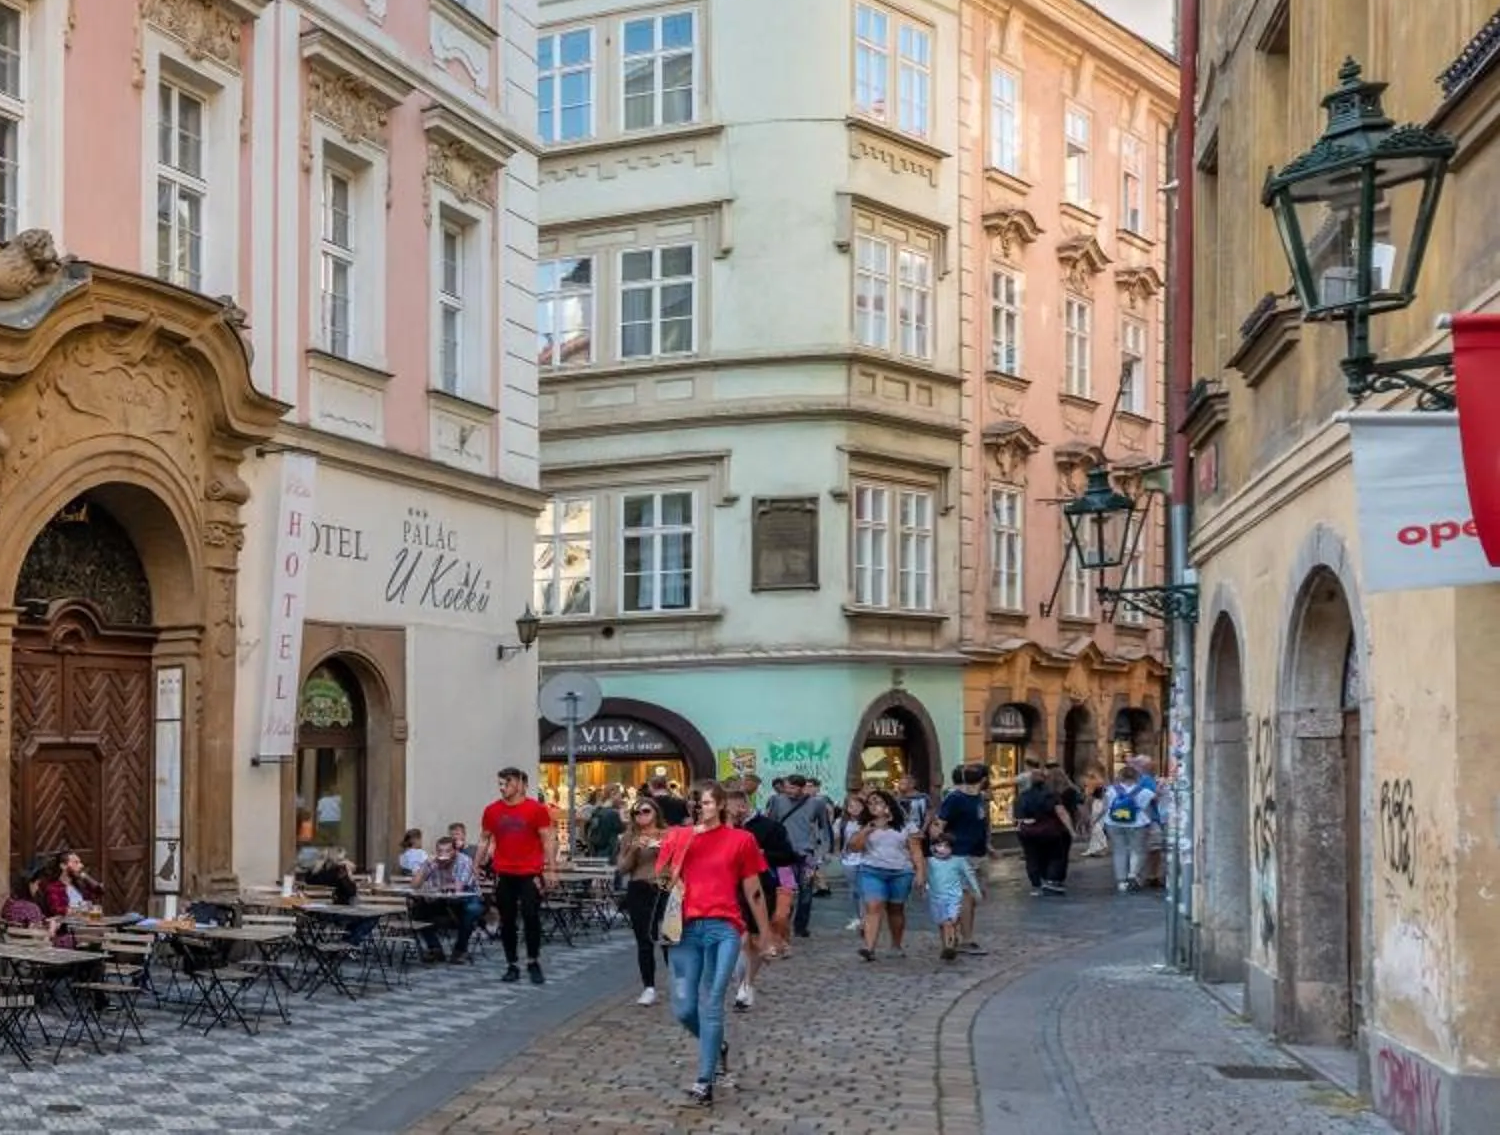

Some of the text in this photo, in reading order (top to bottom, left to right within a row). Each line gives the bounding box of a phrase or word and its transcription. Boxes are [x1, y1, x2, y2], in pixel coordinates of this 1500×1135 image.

[385, 547, 423, 605] U
[275, 511, 302, 700] HOTEL
[581, 724, 633, 743] VILY
